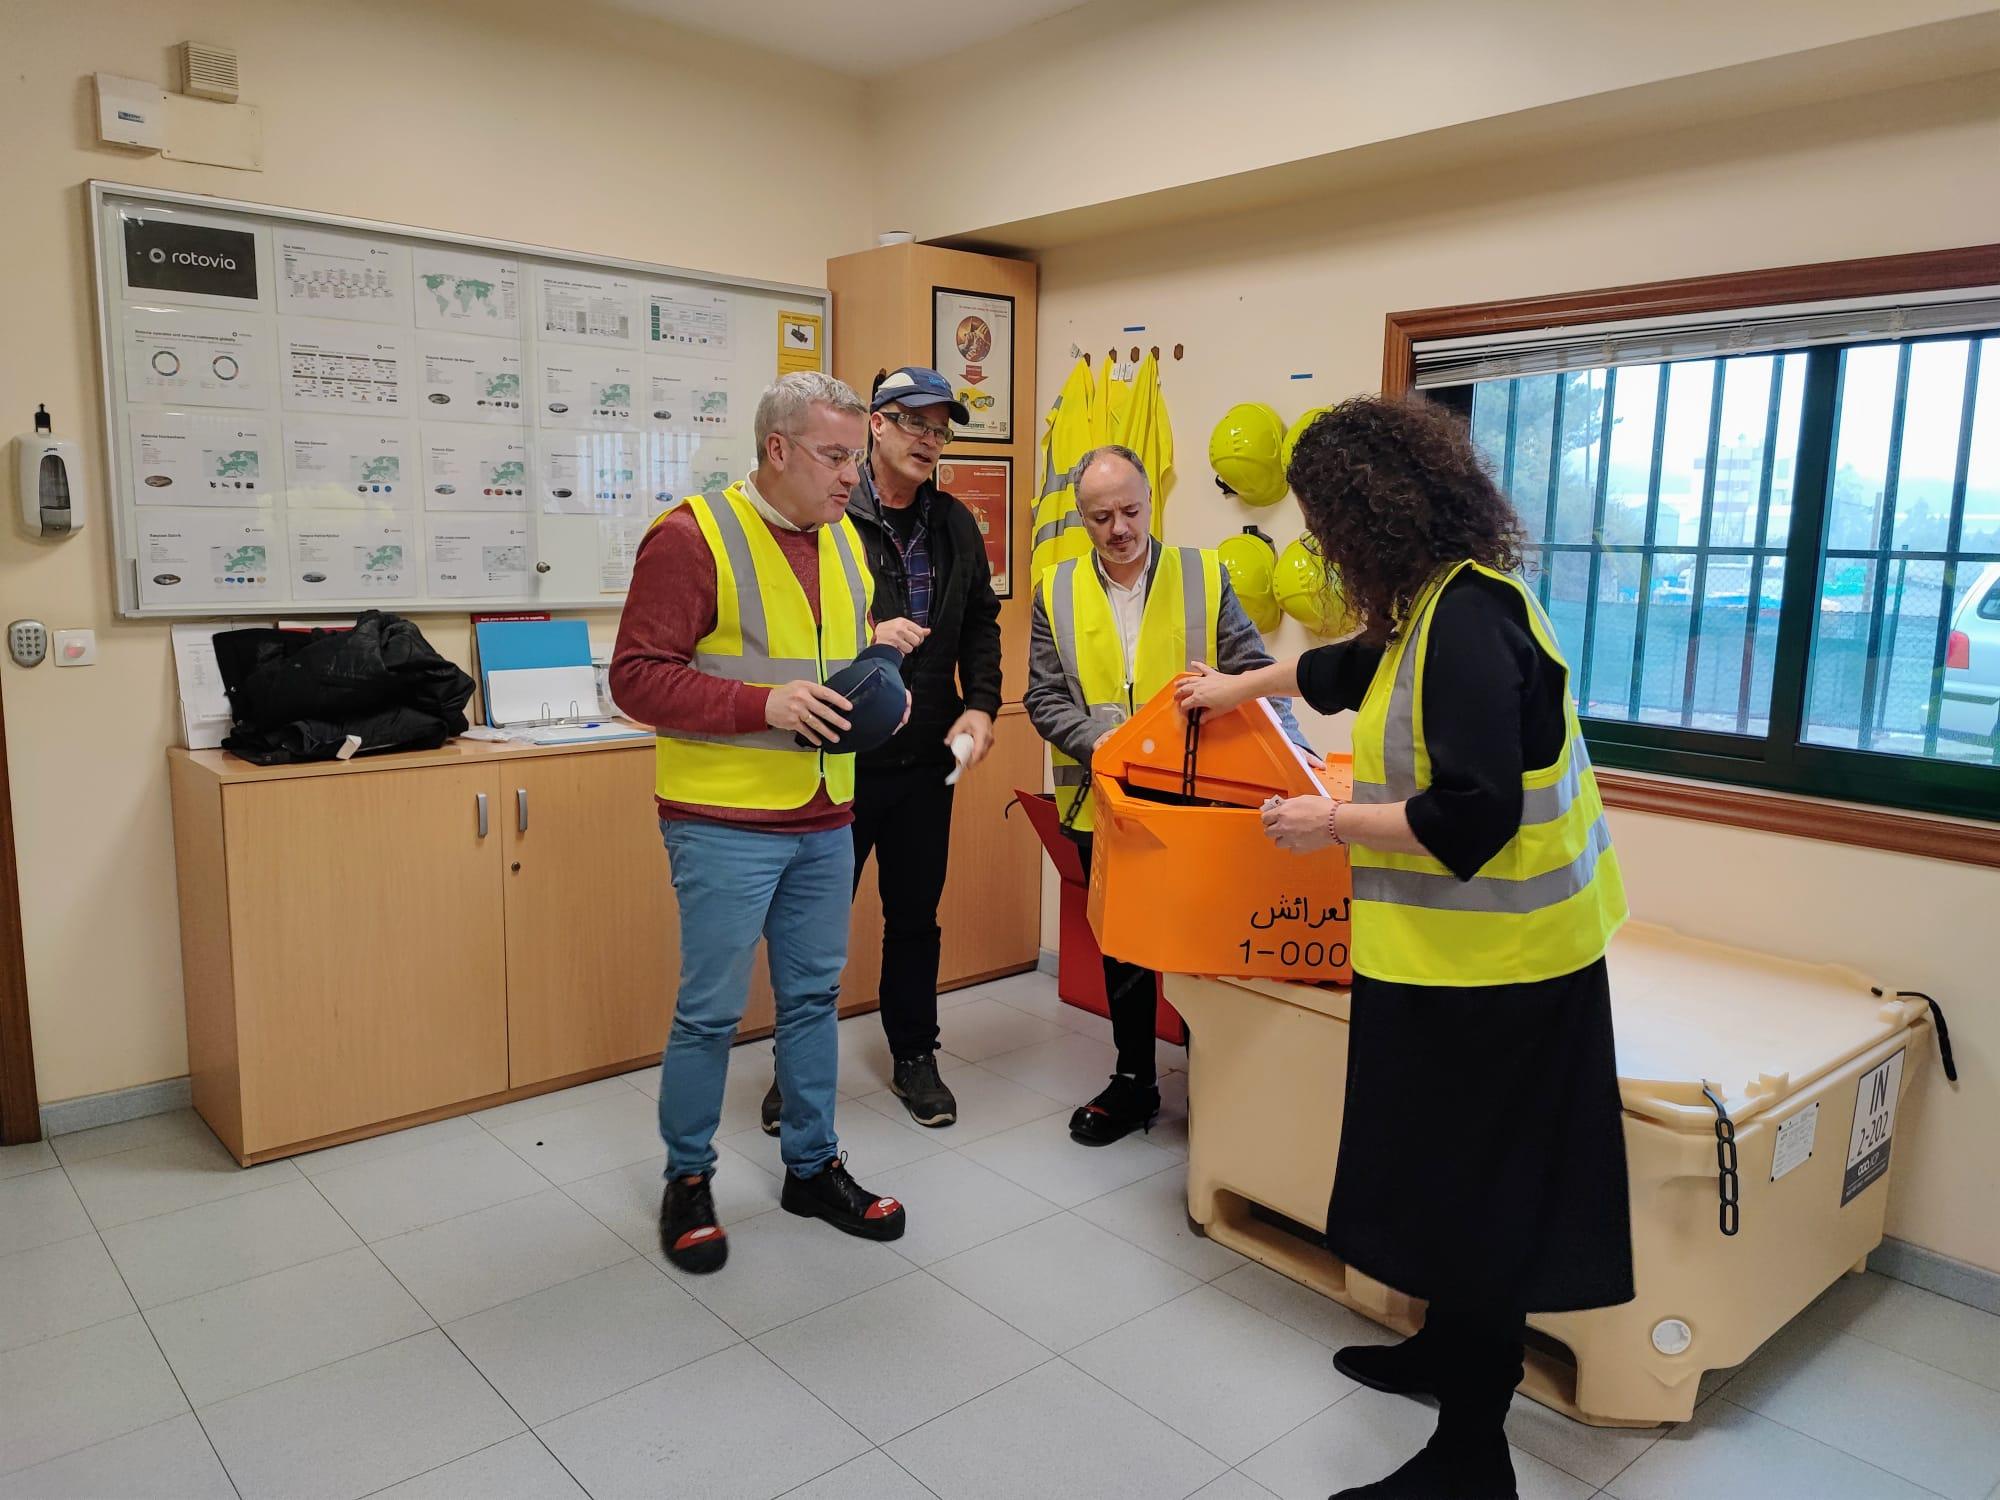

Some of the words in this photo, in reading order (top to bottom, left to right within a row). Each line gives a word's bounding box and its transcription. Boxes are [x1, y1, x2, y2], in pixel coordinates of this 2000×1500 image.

[172, 252, 236, 270] rotovia
[1869, 1064, 1890, 1116] IN
[1857, 1110, 1889, 1156] 2-202
